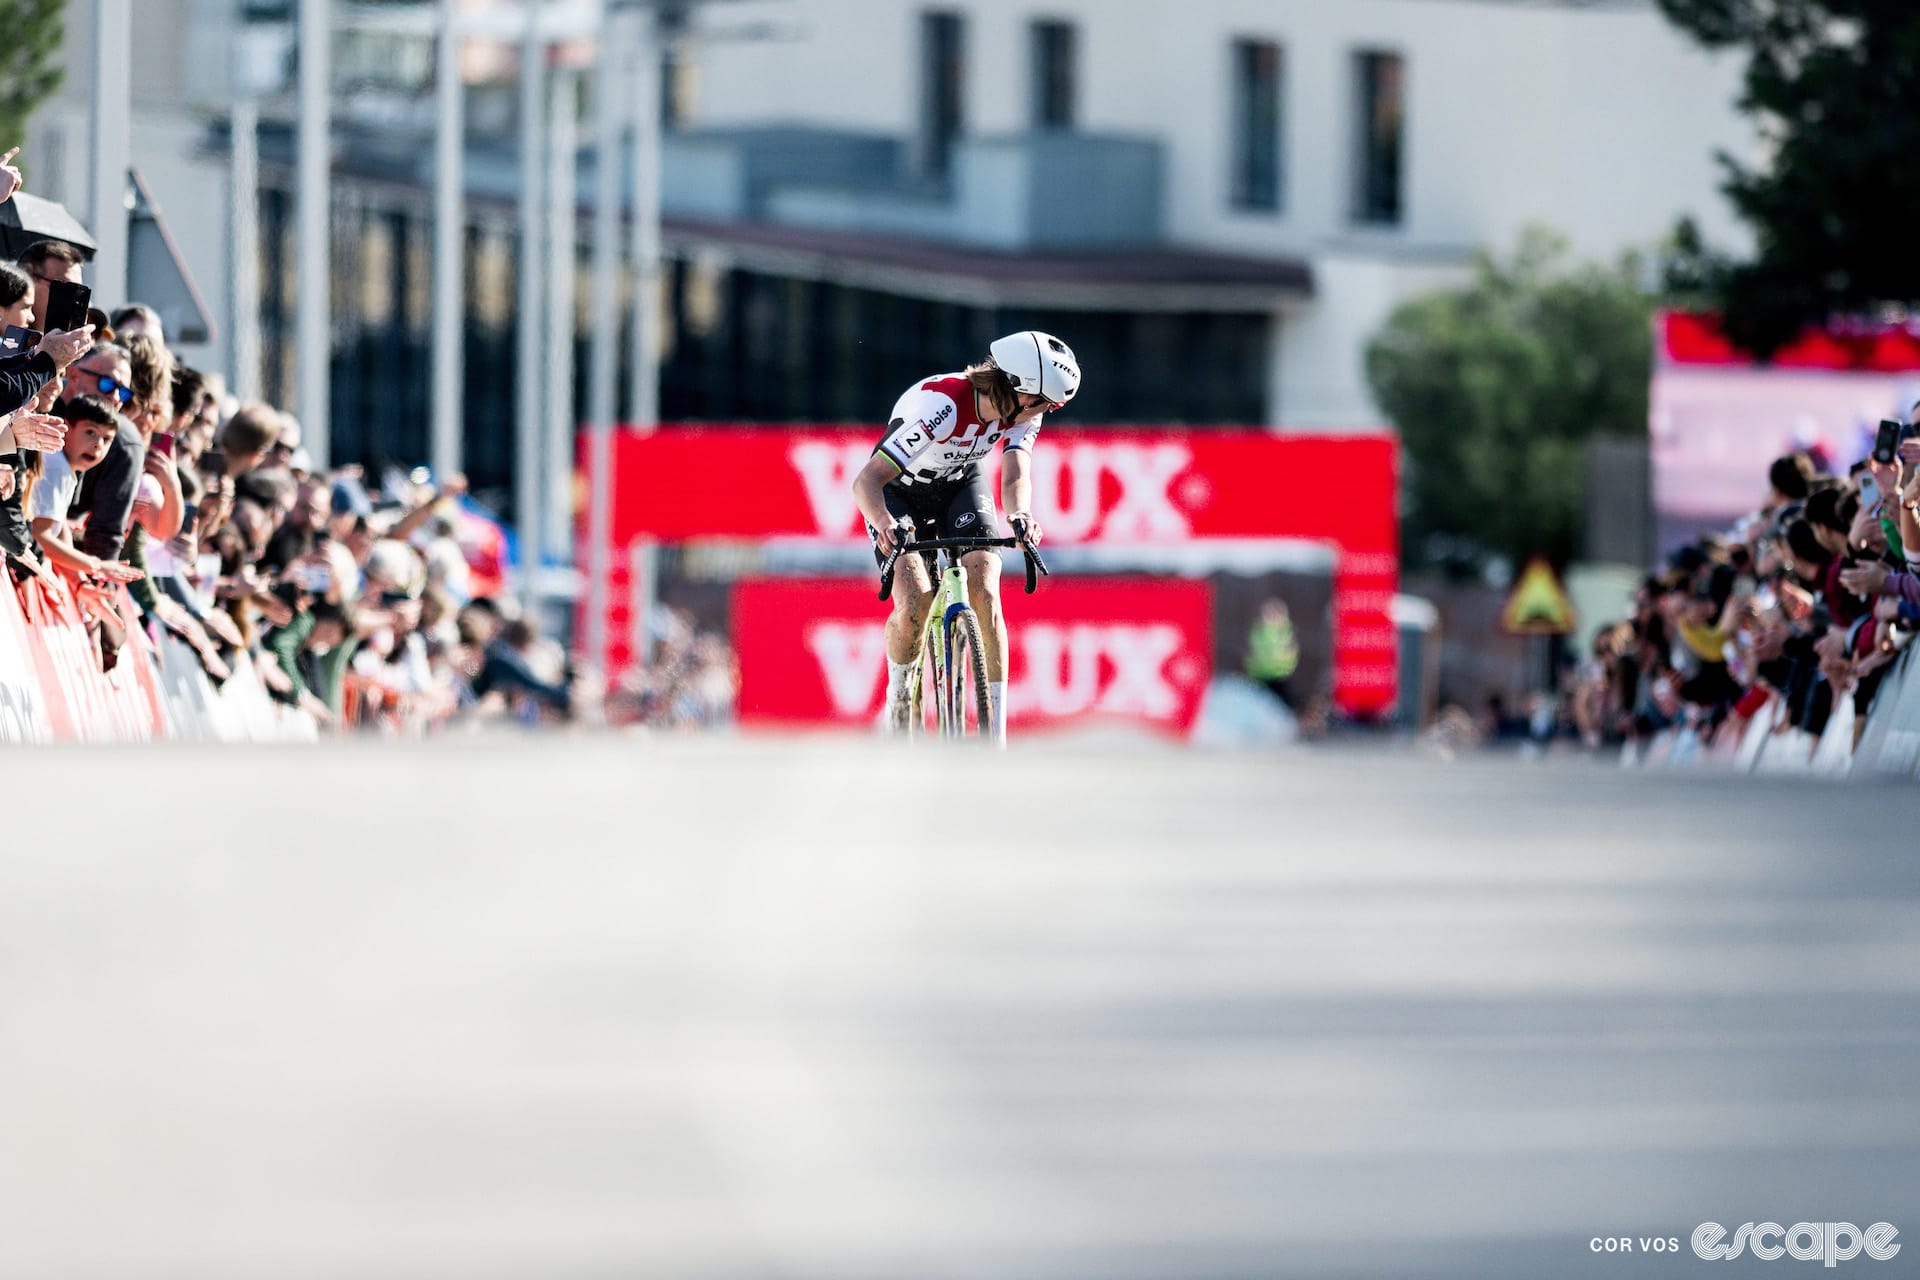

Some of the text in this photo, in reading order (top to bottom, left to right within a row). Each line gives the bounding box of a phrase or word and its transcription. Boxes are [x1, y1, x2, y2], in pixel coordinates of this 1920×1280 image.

[927, 404, 953, 431] aloise
[905, 432, 921, 448] 2
[792, 441, 1191, 543] VUX
